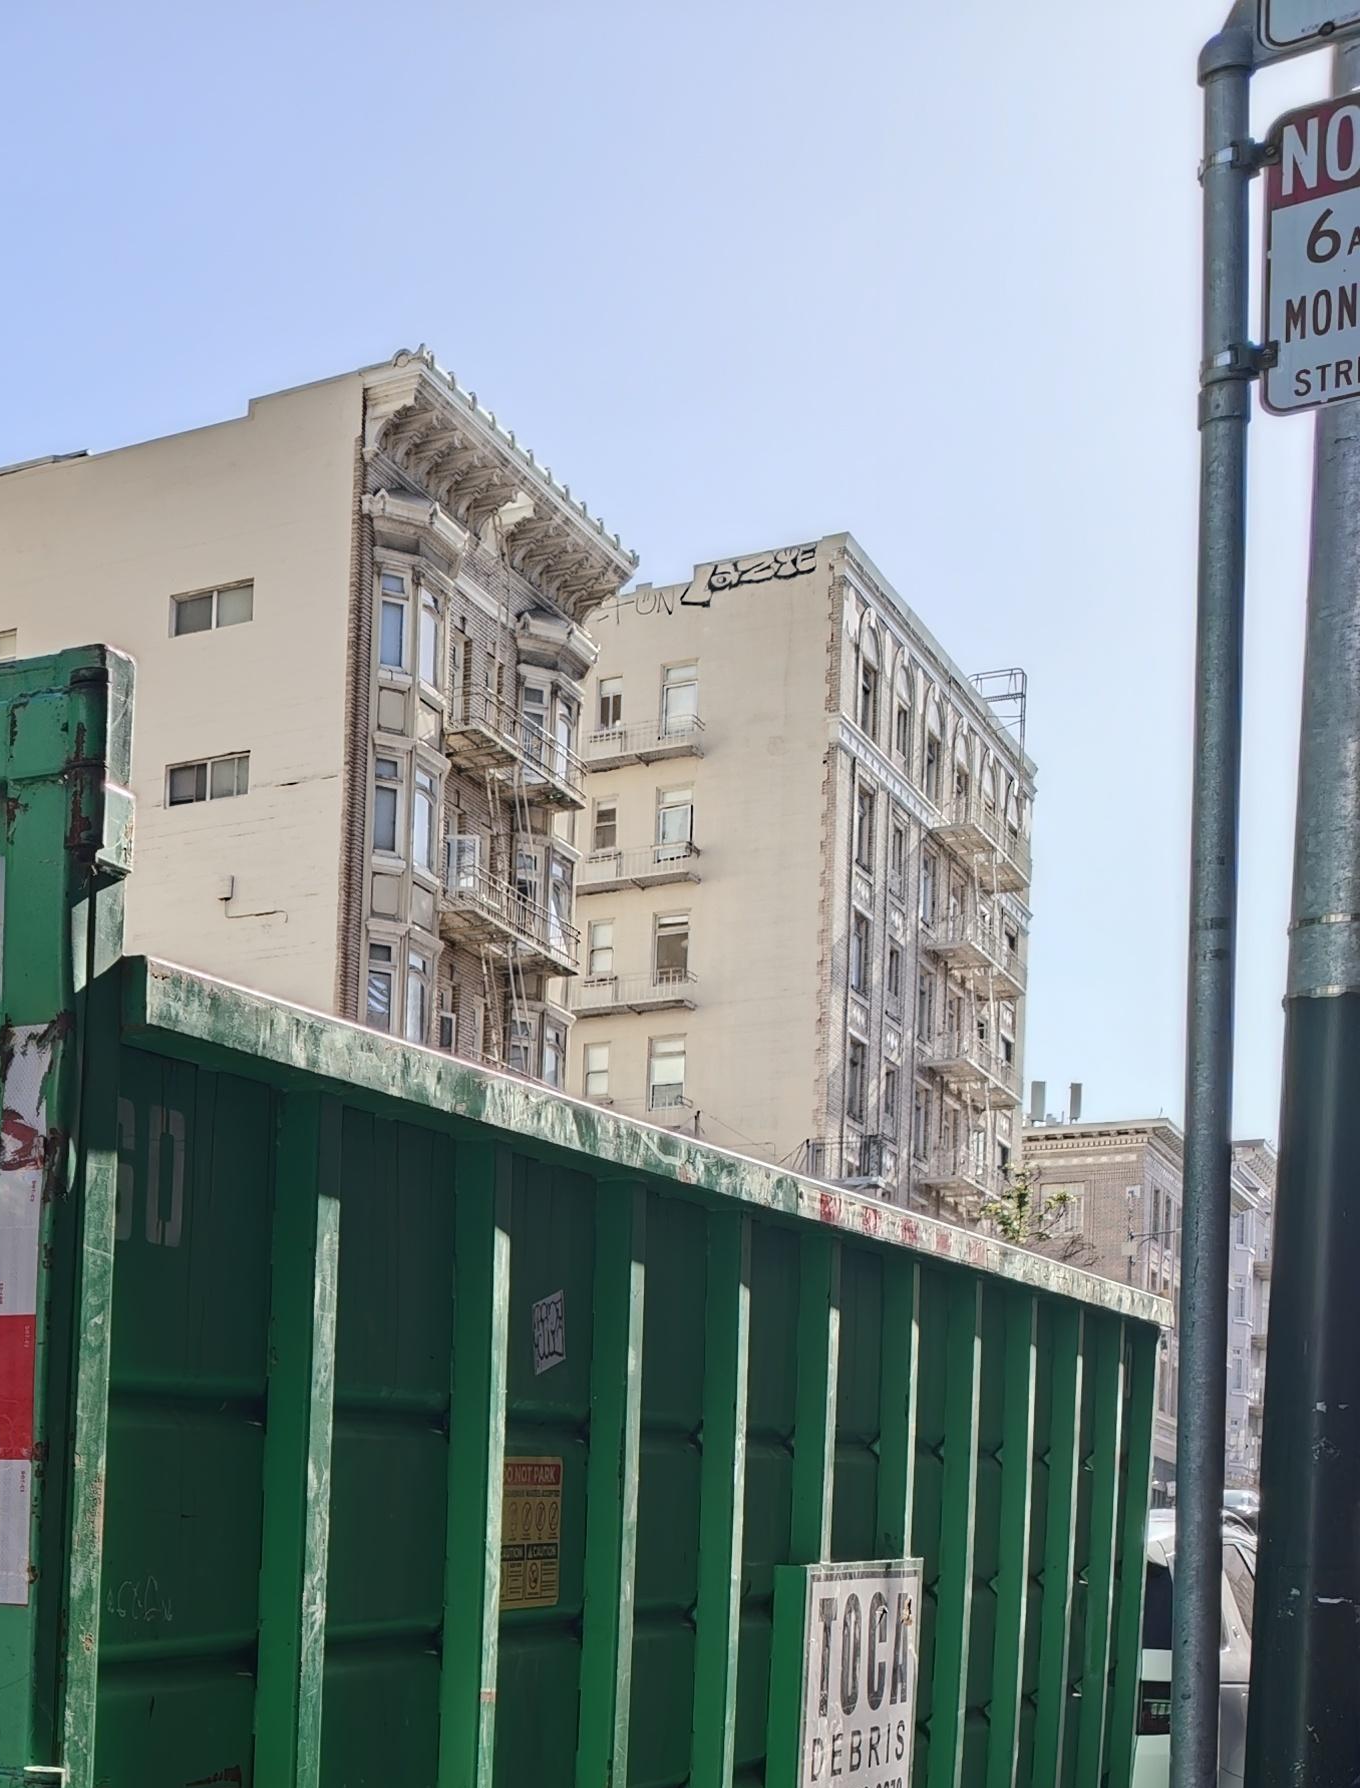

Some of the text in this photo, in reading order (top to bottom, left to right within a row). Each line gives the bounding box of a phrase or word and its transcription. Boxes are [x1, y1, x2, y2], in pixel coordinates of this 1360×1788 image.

[1285, 283, 1358, 344] MON
[1294, 357, 1360, 397] STR
[817, 1591, 912, 1718] TOCA
[810, 1720, 906, 1782] DEBRIS
